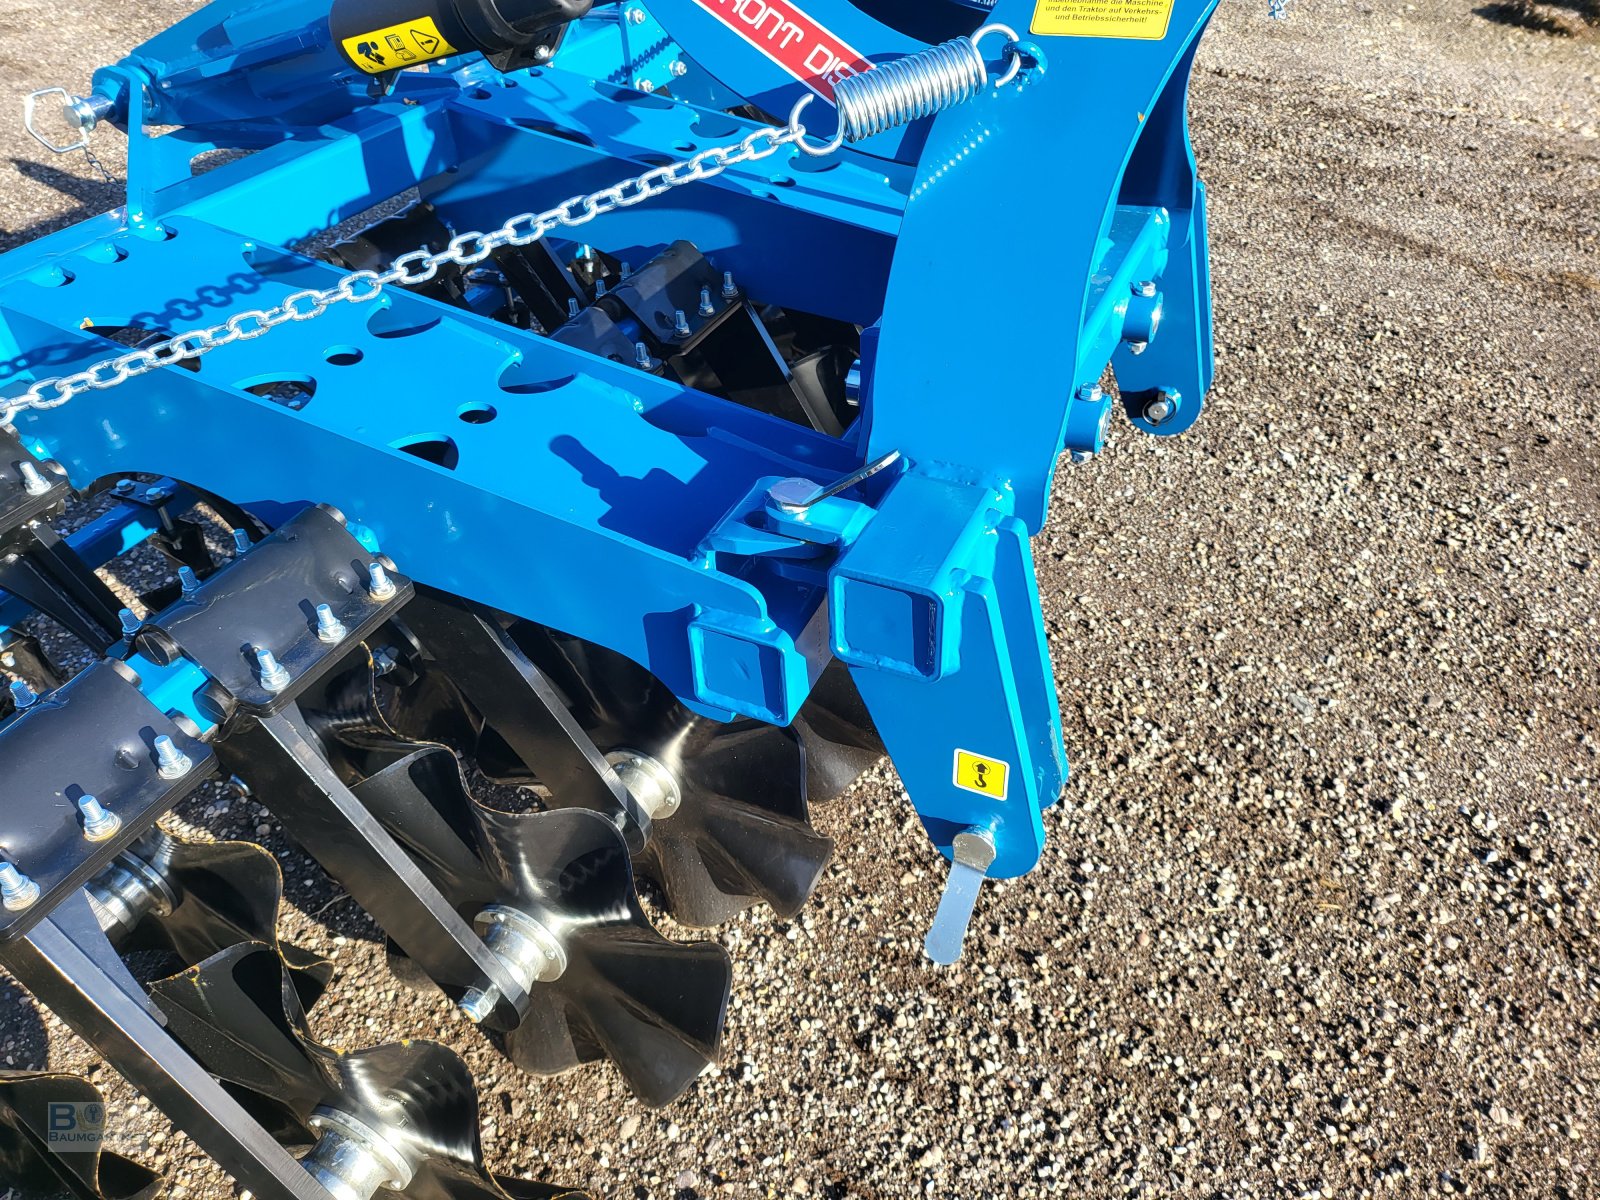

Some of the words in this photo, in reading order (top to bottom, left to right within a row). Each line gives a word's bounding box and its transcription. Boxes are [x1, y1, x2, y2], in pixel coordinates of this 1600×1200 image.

[1079, 5, 1107, 13] Traktor
[1124, 7, 1163, 15] Verkehrs-
[1072, 14, 1148, 23] Betriebssicherheit!
